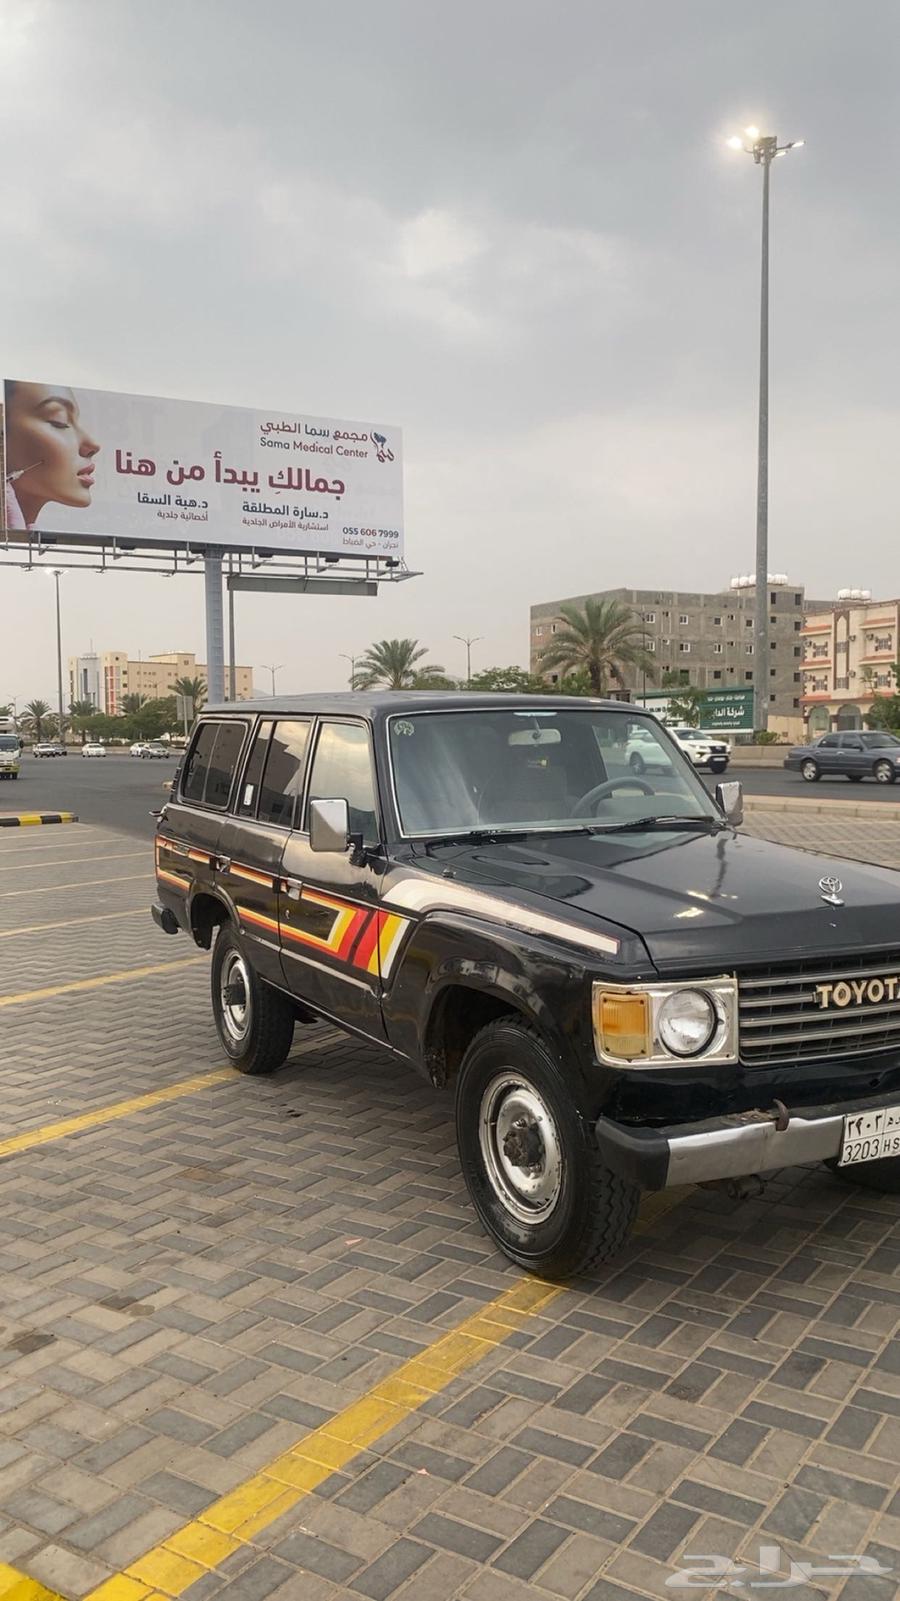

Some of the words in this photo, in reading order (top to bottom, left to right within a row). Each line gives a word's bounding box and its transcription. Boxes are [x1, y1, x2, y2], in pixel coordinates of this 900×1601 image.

[260, 421, 301, 435] الطبي
[304, 424, 330, 438] سما
[333, 430, 368, 443] مجمع
[260, 436, 290, 450] Sama
[293, 440, 333, 455] Medical
[336, 445, 368, 458] Center
[115, 449, 156, 476] هنا
[166, 460, 205, 485] من
[213, 451, 260, 493] يبدأ
[137, 492, 171, 506] السقا
[157, 510, 178, 520] جلدية
[242, 501, 289, 516] المطلقة
[242, 517, 267, 527] الجلدية
[342, 526, 359, 535] 055
[360, 528, 377, 537] 606
[378, 529, 399, 538] 7999
[843, 1138, 880, 1163] 3203
